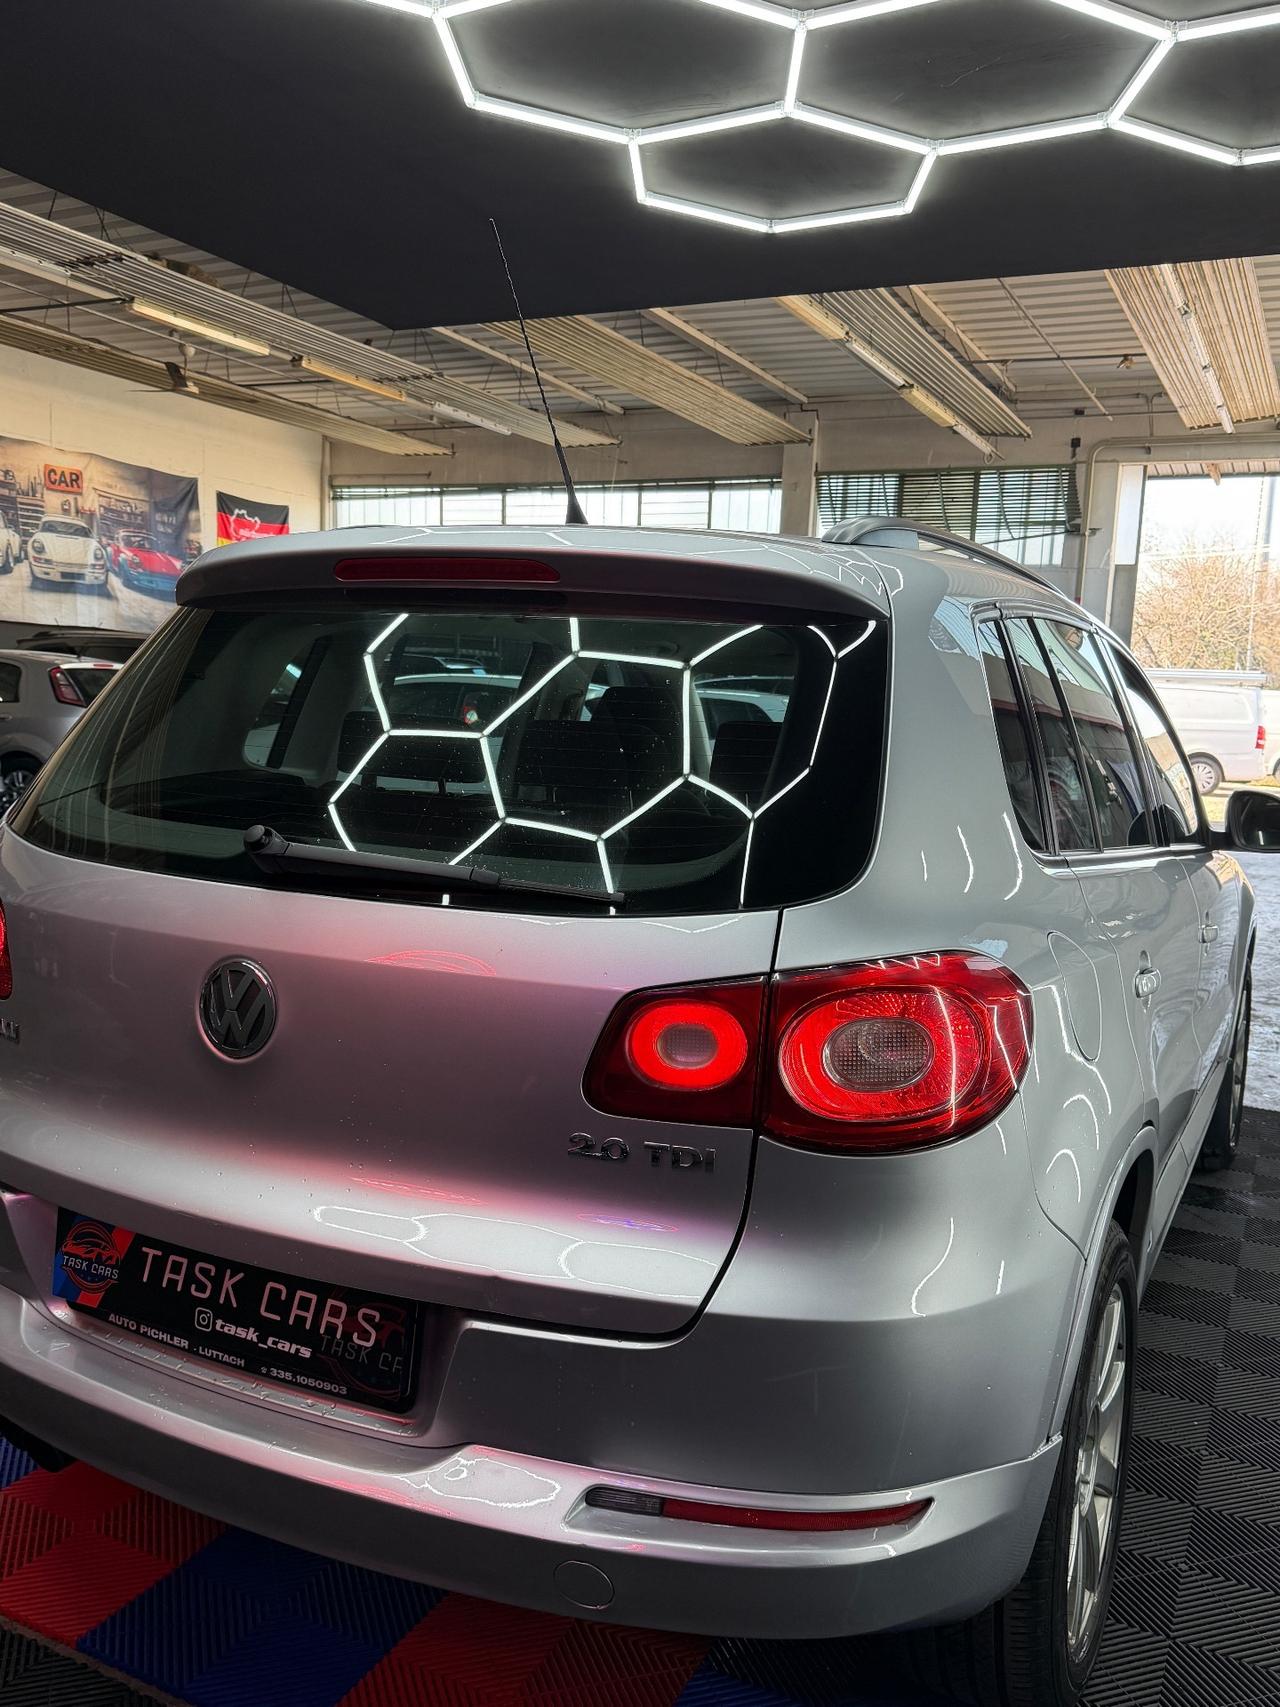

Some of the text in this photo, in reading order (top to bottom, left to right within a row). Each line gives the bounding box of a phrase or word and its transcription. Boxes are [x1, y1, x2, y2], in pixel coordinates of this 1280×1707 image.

[47, 468, 81, 489] CAR
[643, 1141, 716, 1173] TDI
[63, 1255, 119, 1280] TASK CARS
[141, 1246, 382, 1348] TASK CARS
[108, 1313, 137, 1331] AUTO
[140, 1324, 189, 1350] PICHLER
[199, 1346, 245, 1368] LUTTACH
[269, 1366, 348, 1396] 335.1050903
[215, 1318, 313, 1359] task_cars
[321, 1334, 371, 1365] TASK
